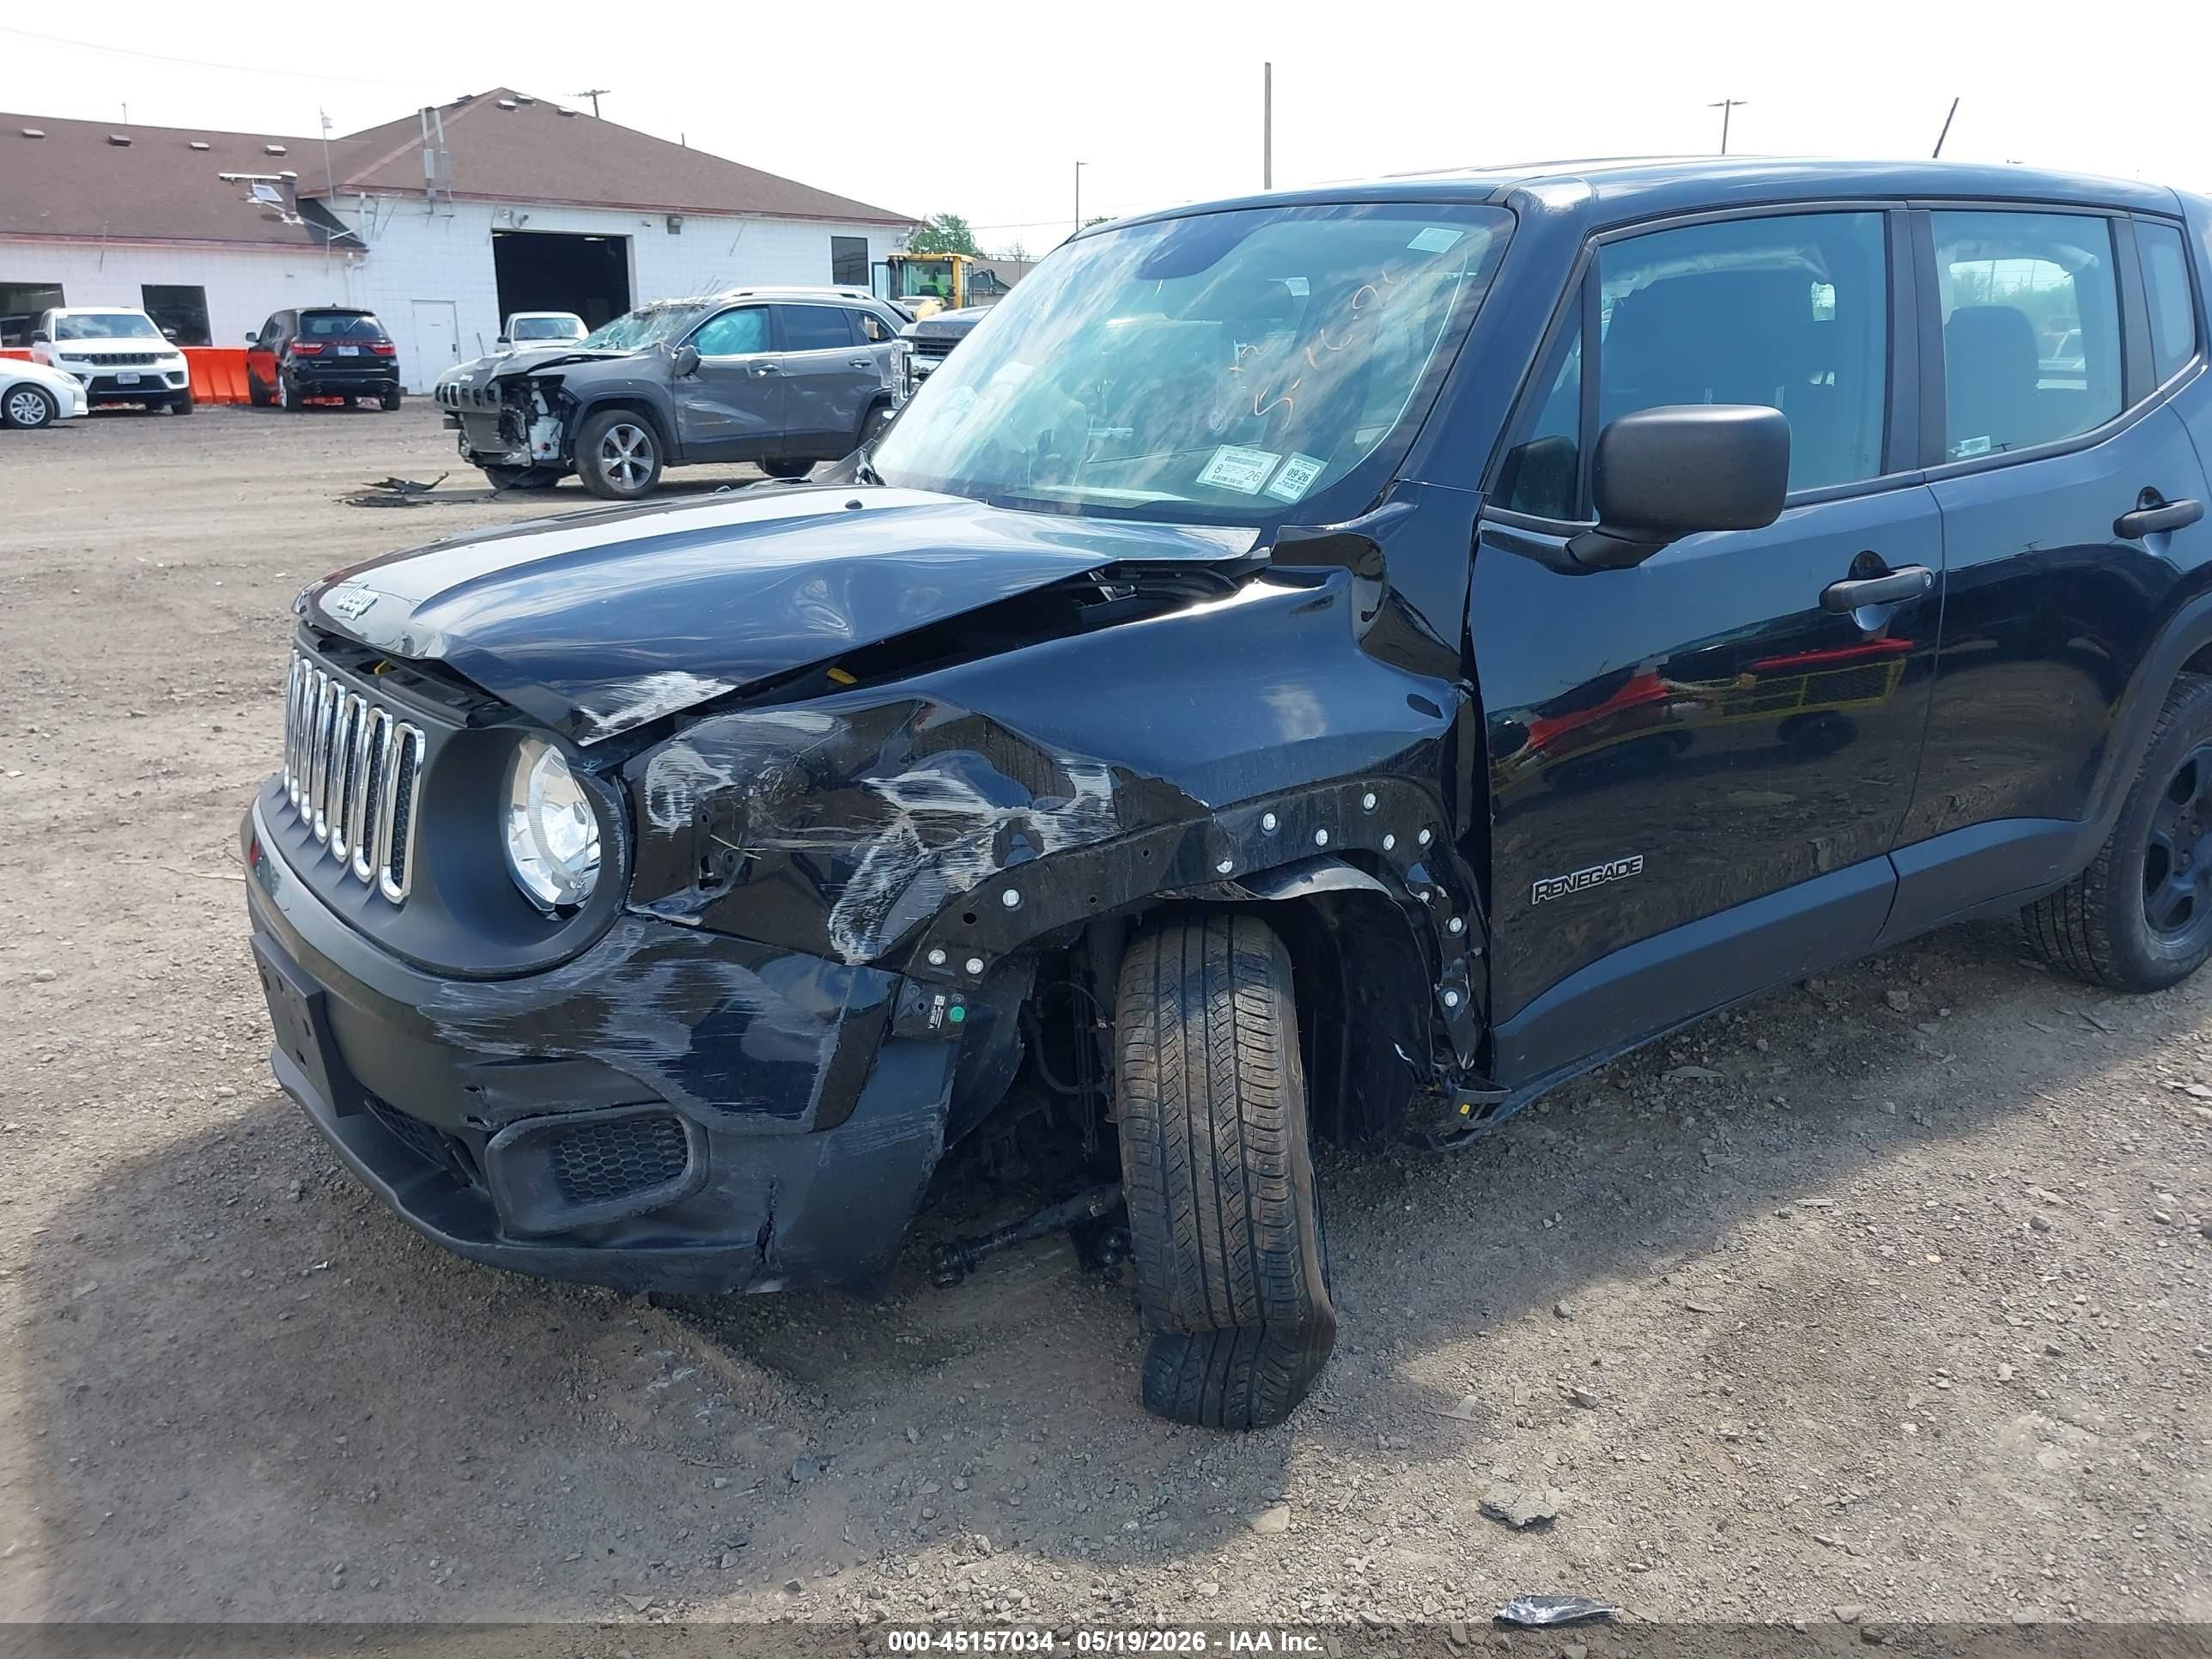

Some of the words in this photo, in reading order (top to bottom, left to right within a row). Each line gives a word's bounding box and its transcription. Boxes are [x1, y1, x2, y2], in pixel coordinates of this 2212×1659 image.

[1214, 464, 1224, 474] 8
[1245, 471, 1262, 482] 26
[1532, 855, 1644, 904] RENEGADE
